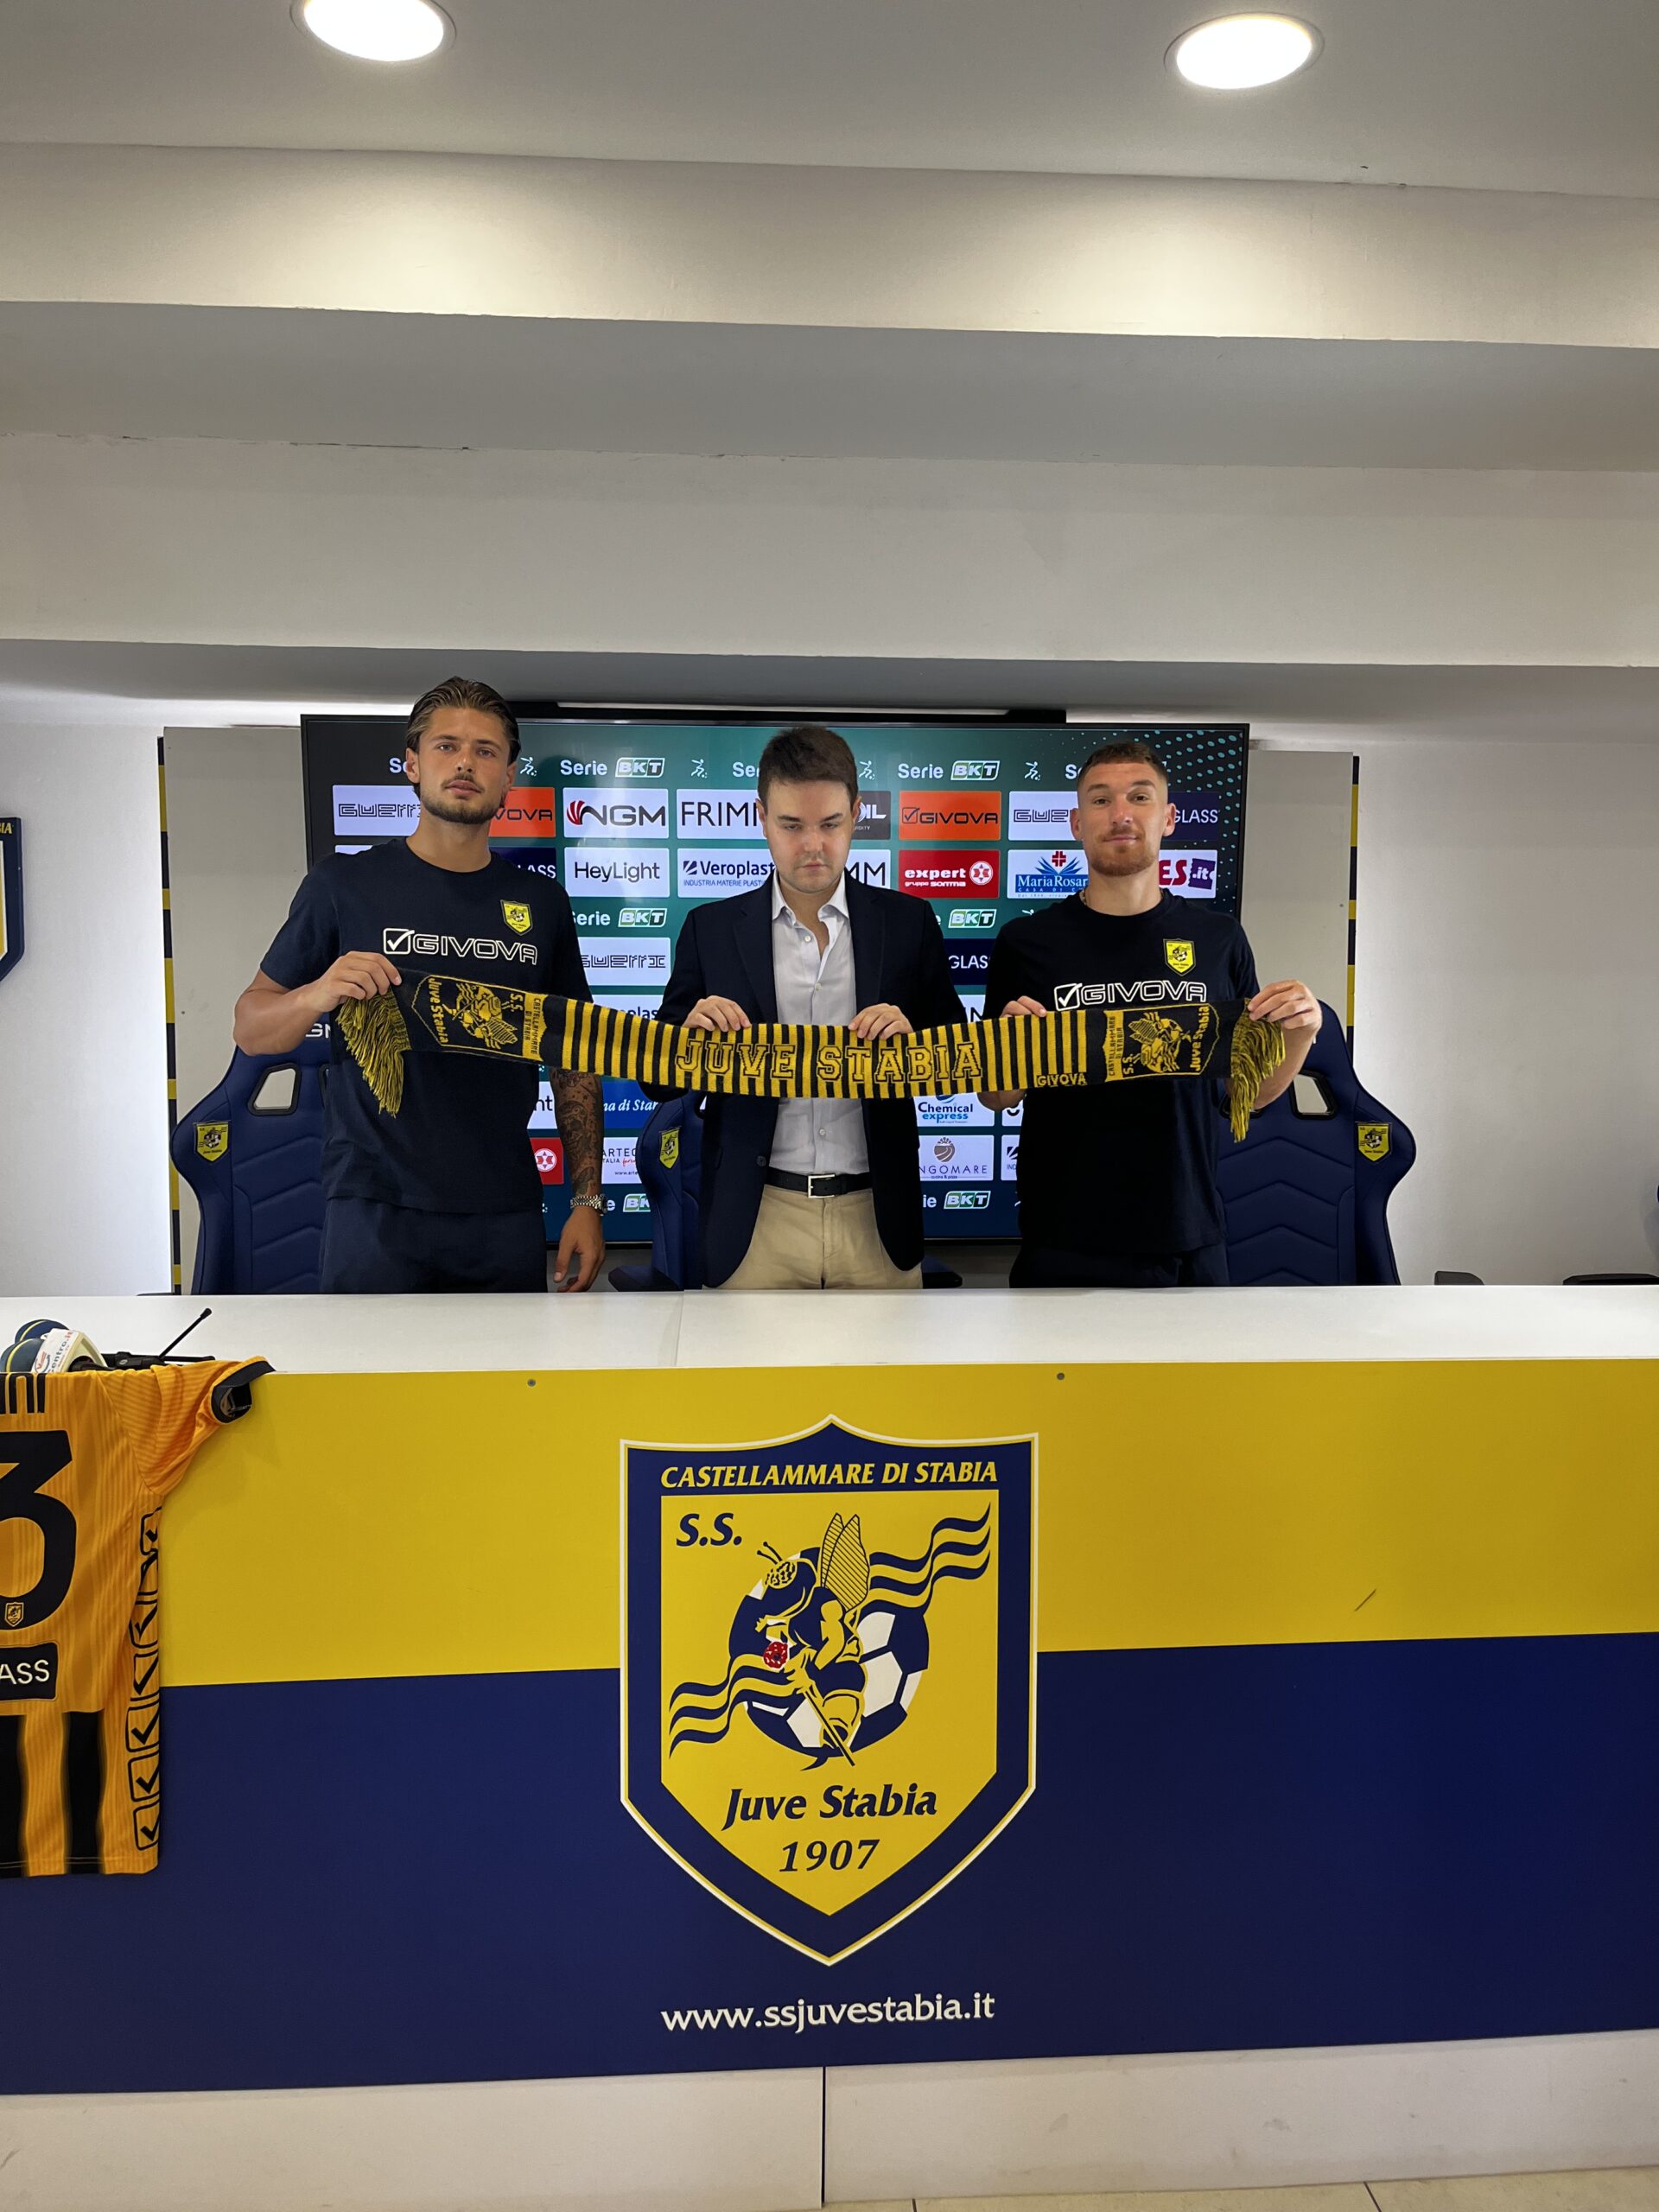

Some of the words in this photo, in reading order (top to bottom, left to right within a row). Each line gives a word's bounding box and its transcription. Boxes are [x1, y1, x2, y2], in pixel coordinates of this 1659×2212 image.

[560, 760, 607, 776] Serie
[617, 760, 663, 775] BKT
[898, 763, 944, 779] Serie
[953, 764, 997, 778] BKT
[494, 809, 553, 822] VOVA
[580, 804, 666, 827] NGM
[681, 801, 757, 827] FRIM
[919, 812, 998, 824] GIVOVA
[574, 861, 660, 882] HeyLight
[905, 868, 966, 880] expert
[573, 911, 611, 926] erie
[620, 911, 666, 925] BKT
[950, 912, 994, 925] BKT
[412, 934, 538, 965] GIVOVA
[948, 955, 988, 969] GLAS
[429, 978, 442, 1004] Juve
[1080, 980, 1208, 1005] GIVOVA
[430, 1005, 449, 1044] Stabia
[1193, 1006, 1210, 1039] Stabia
[675, 1038, 796, 1080] JUVE
[816, 1040, 983, 1084] STABIA
[1190, 1041, 1202, 1071] Juve
[1037, 1073, 1086, 1086] GIVOVA
[918, 1102, 974, 1113] Chemical
[922, 1113, 969, 1123] express
[919, 1165, 988, 1175] NGOMARE
[625, 1198, 651, 1209] BK
[946, 1194, 988, 1206] BKT
[660, 1462, 874, 1488] CASTELLAMMARE
[881, 1462, 906, 1484] DI
[916, 1461, 997, 1484] STABIA
[676, 1513, 742, 1547] S.S.
[721, 1788, 806, 1831] Juve
[819, 1783, 938, 1819] Stabia
[779, 1839, 880, 1872] 1907
[660, 1992, 995, 2034] www.ssjuvestabia.it
